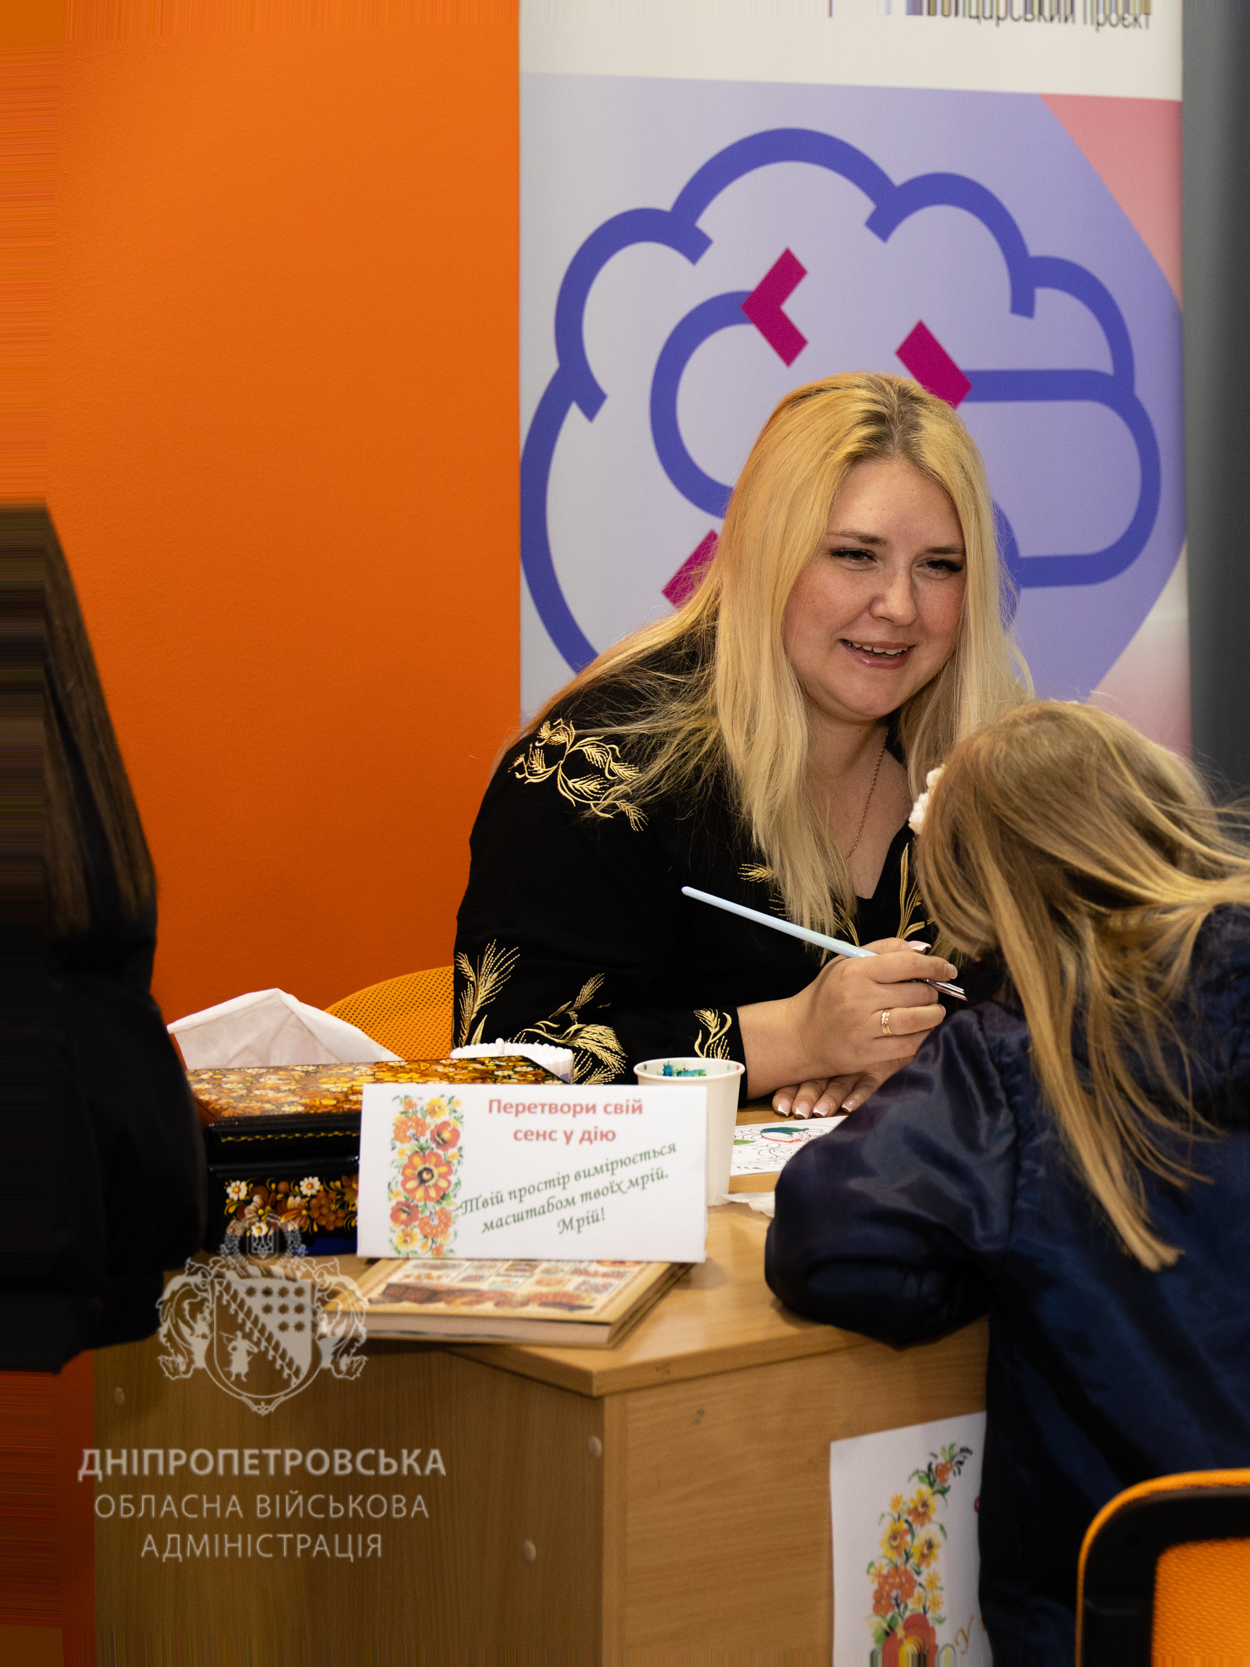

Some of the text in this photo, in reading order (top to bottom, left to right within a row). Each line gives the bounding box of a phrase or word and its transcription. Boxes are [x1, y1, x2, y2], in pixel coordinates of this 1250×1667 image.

[488, 1097, 643, 1117] Перетвори свій
[513, 1126, 617, 1146] сенс у дію
[453, 1141, 677, 1216] Твій простір вимірюється
[482, 1168, 669, 1234] масштабом твоїх мрій.
[557, 1207, 605, 1235] Мрій!
